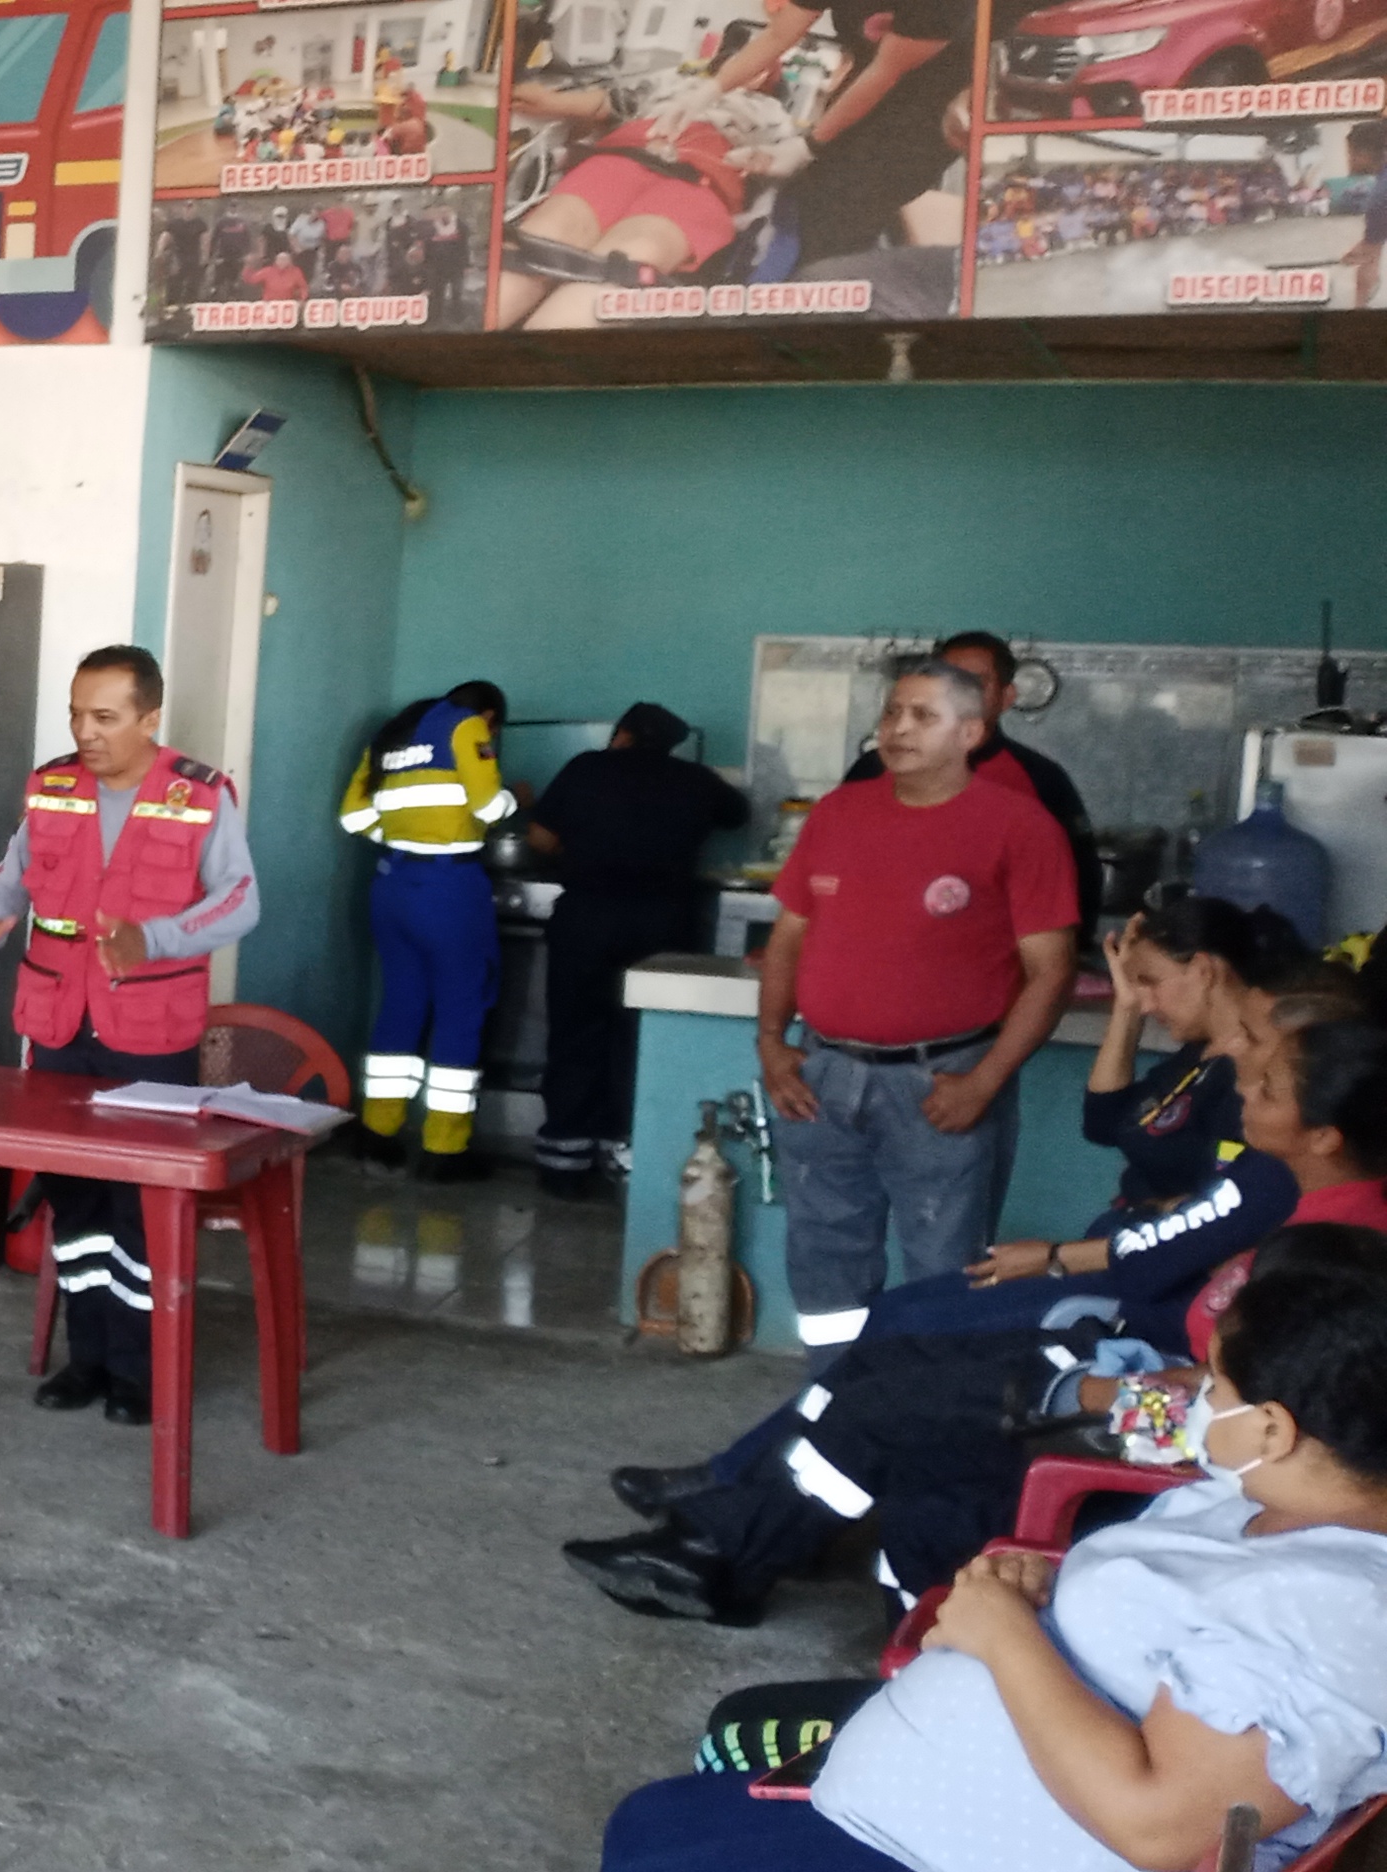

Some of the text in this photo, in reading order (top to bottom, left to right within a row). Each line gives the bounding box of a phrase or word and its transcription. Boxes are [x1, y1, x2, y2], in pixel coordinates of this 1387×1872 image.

[1145, 82, 1382, 119] TRANSPARENCIA
[223, 155, 429, 191] RESPONSABILIDAD
[599, 283, 869, 316] CALIDAD EN SERVICIO
[1170, 272, 1327, 301] DISCIPLINA
[194, 297, 426, 328] TRABAJO EN EQUIPO
